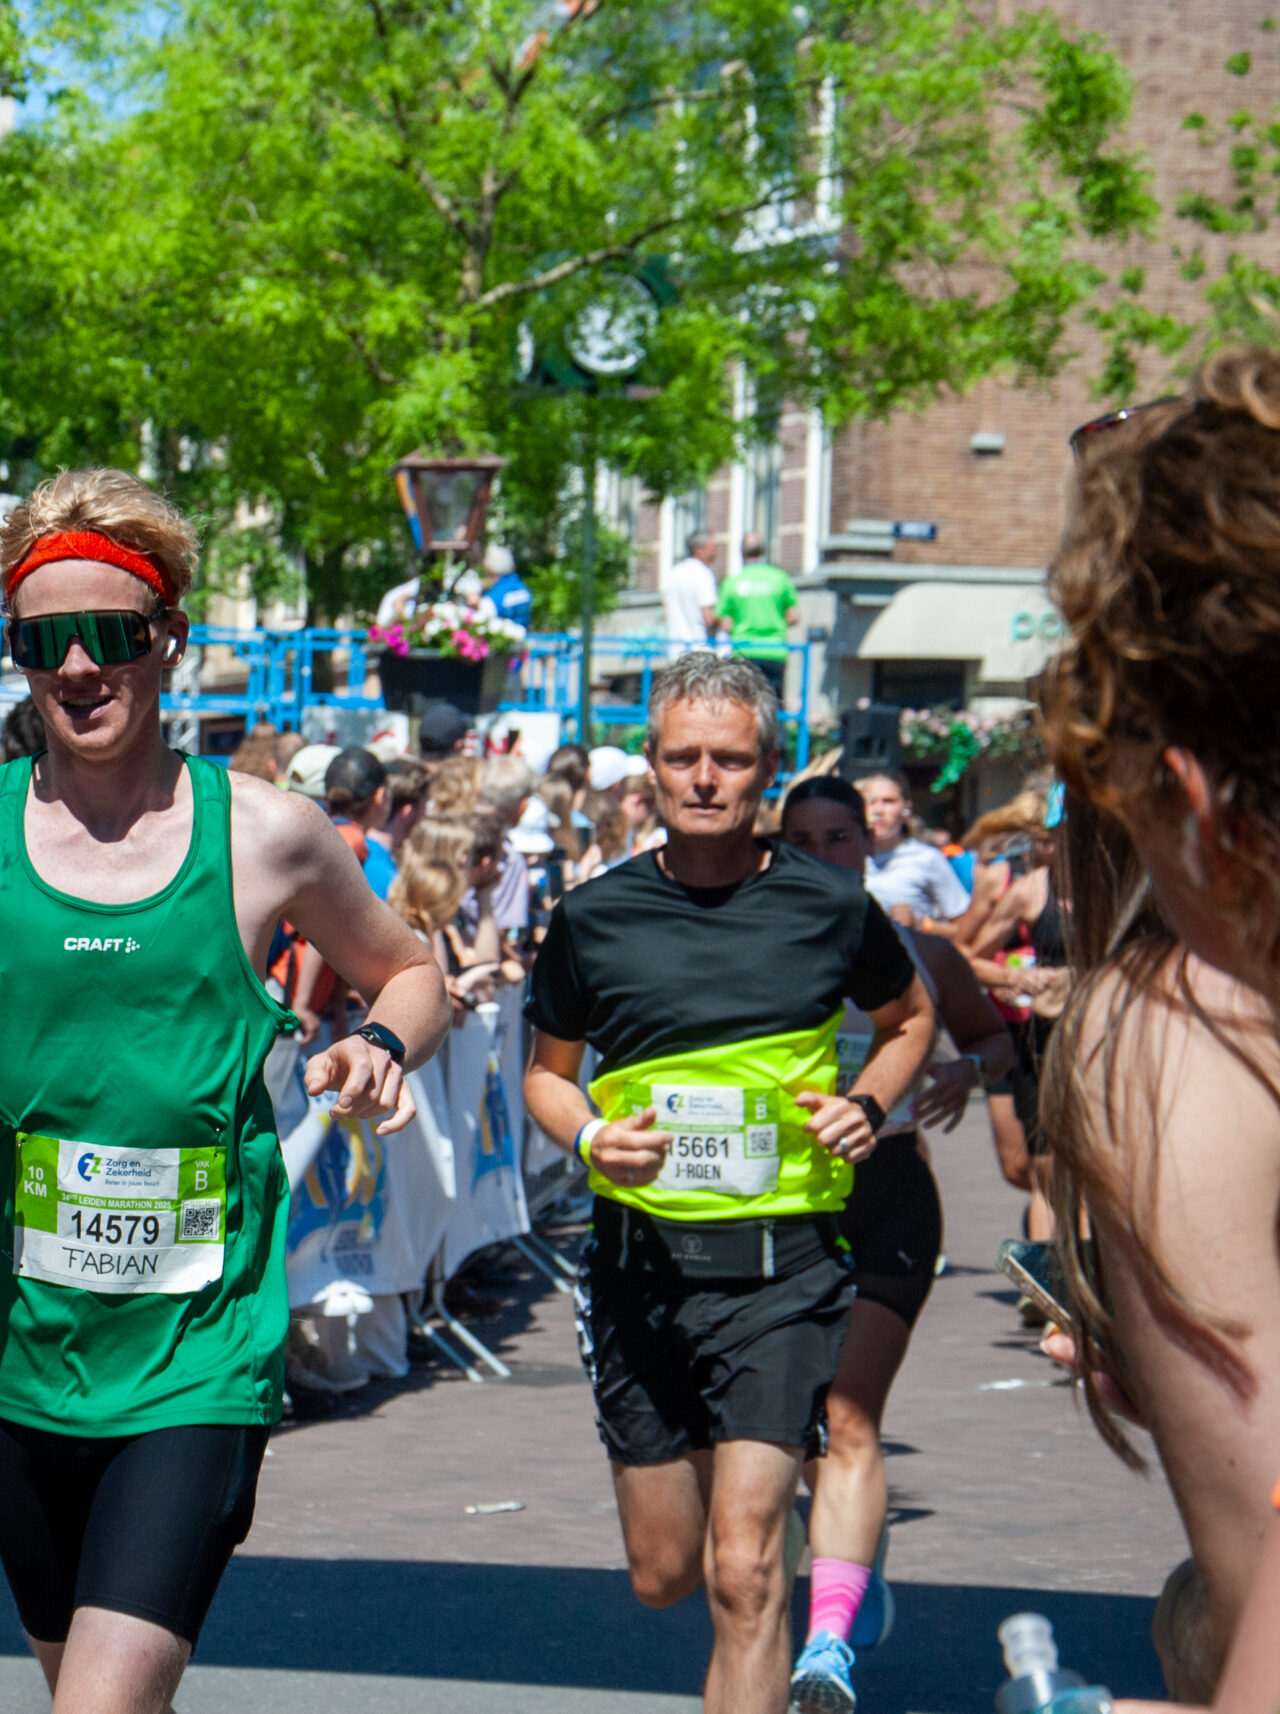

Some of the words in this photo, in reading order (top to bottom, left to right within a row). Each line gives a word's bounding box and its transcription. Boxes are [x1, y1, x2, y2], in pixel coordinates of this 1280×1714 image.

[64, 937, 124, 952] CRAFT
[106, 1158, 128, 1168] Zorg
[27, 1166, 44, 1181] 10
[106, 1168, 152, 1177] Zekerheid
[195, 1170, 208, 1191] B
[23, 1181, 48, 1198] KM
[79, 1196, 106, 1207] LEIDEN
[108, 1199, 153, 1209] MARATHON
[154, 1201, 172, 1209] 2025
[71, 1210, 160, 1245] 14579
[62, 1246, 159, 1275] FABIAN
